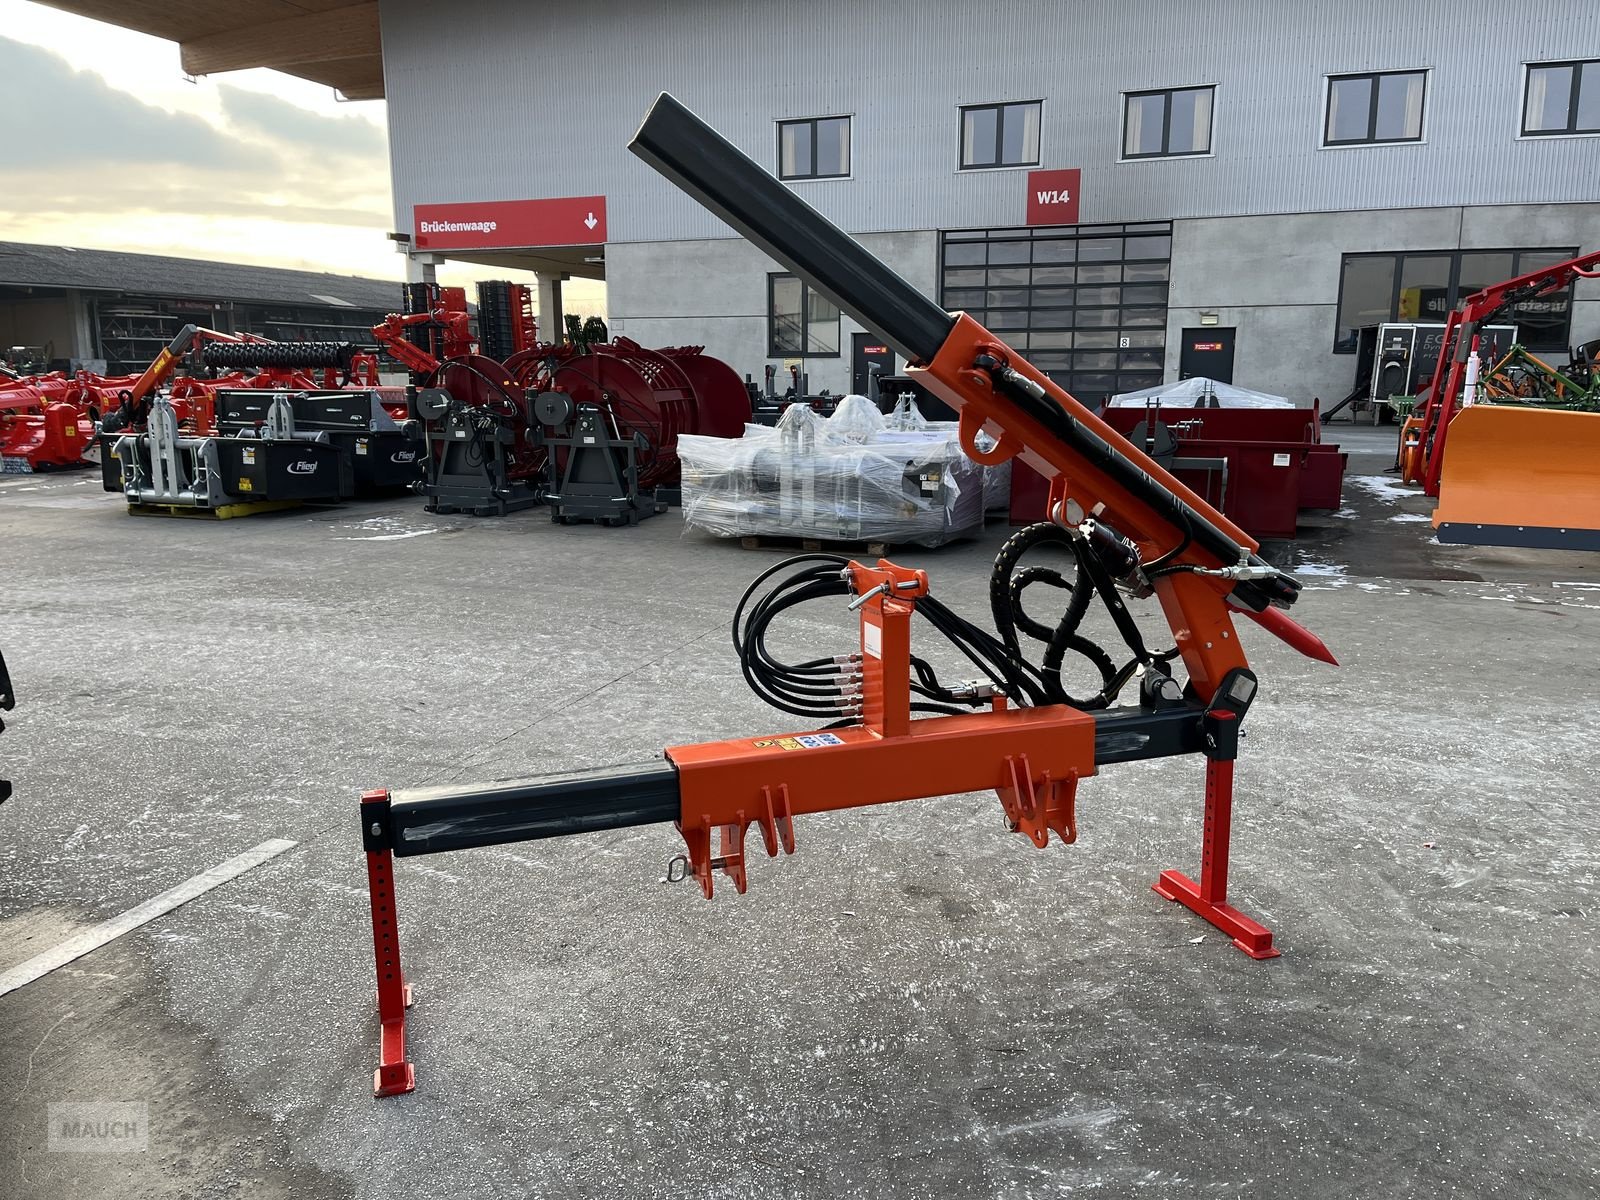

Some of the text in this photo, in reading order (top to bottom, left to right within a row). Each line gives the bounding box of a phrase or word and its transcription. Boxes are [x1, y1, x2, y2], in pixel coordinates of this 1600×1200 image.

[1037, 190, 1070, 205] W14
[420, 220, 497, 233] Brückenwaage
[1121, 338, 1128, 347] 8
[295, 460, 318, 473] Fliegl
